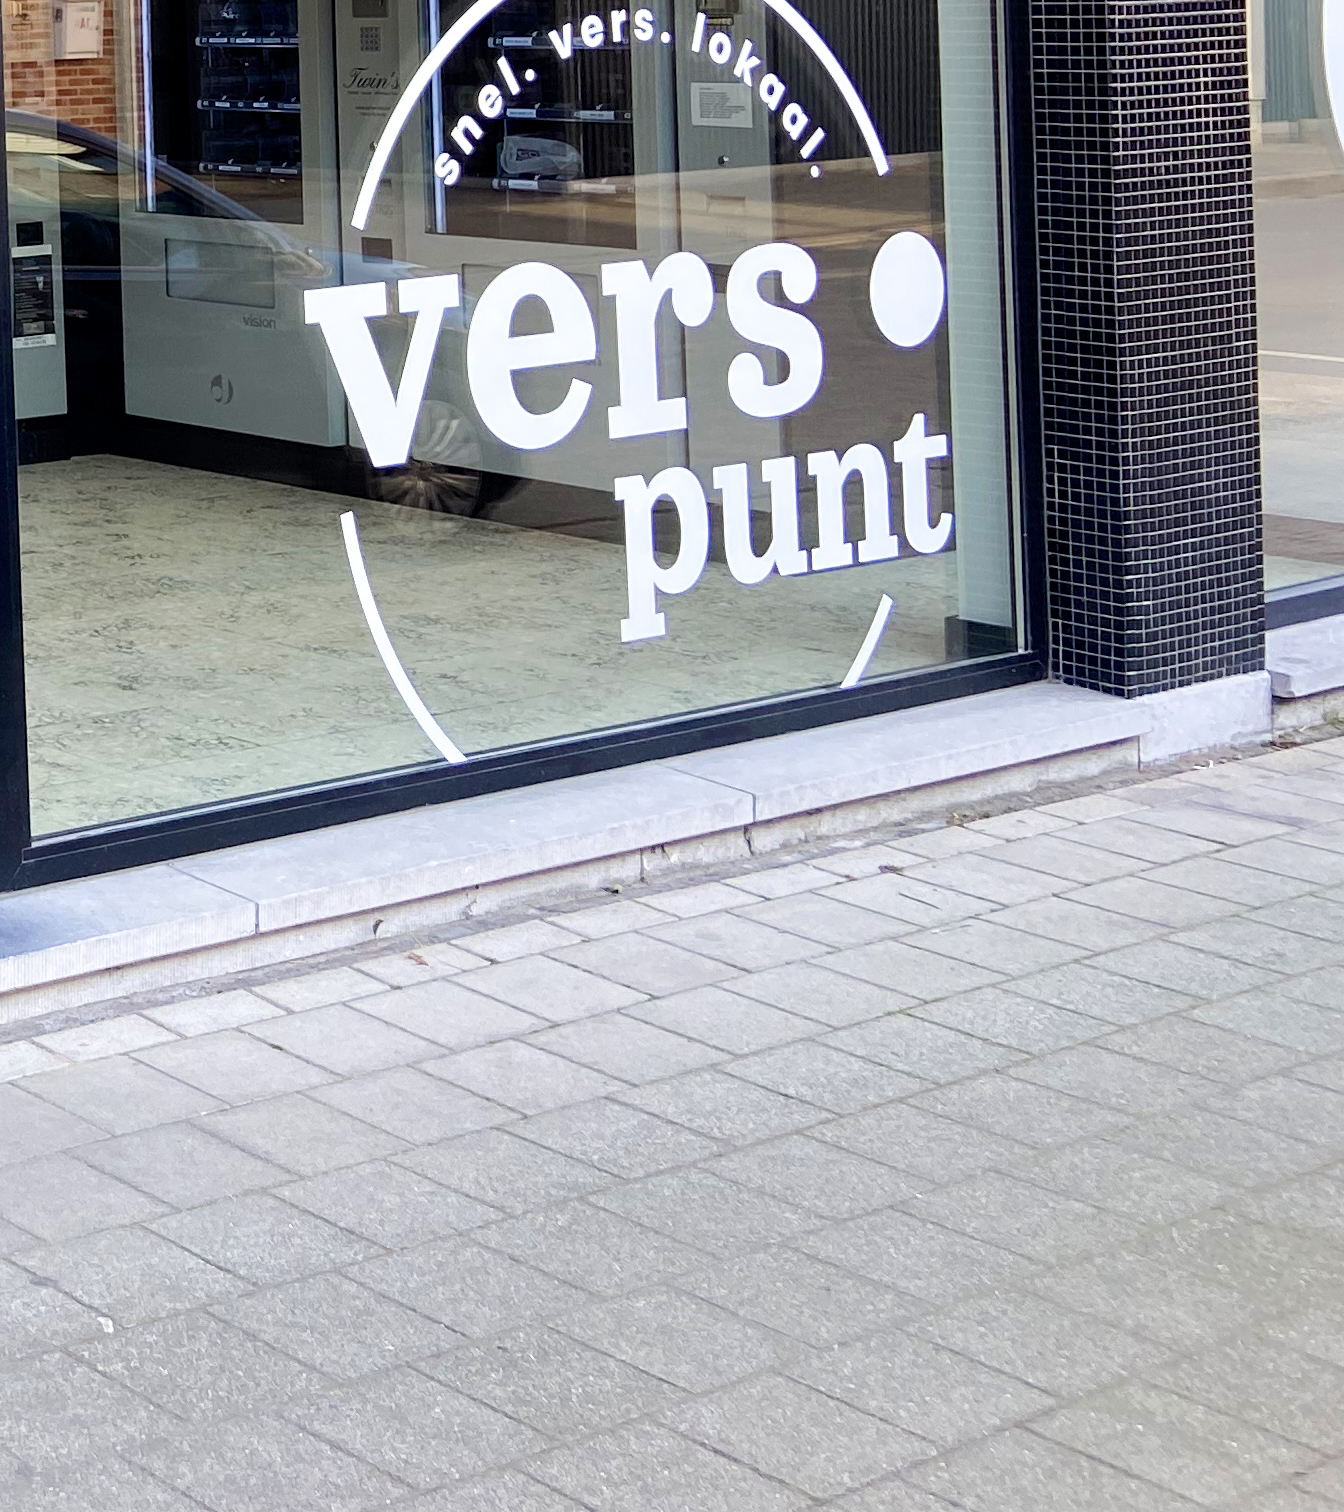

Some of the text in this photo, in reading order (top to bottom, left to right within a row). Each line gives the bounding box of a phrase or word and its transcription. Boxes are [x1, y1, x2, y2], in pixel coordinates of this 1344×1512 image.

[435, 8, 829, 185] snel. vers. lokaal.
[303, 241, 824, 469] vers
[613, 412, 954, 643] punt
